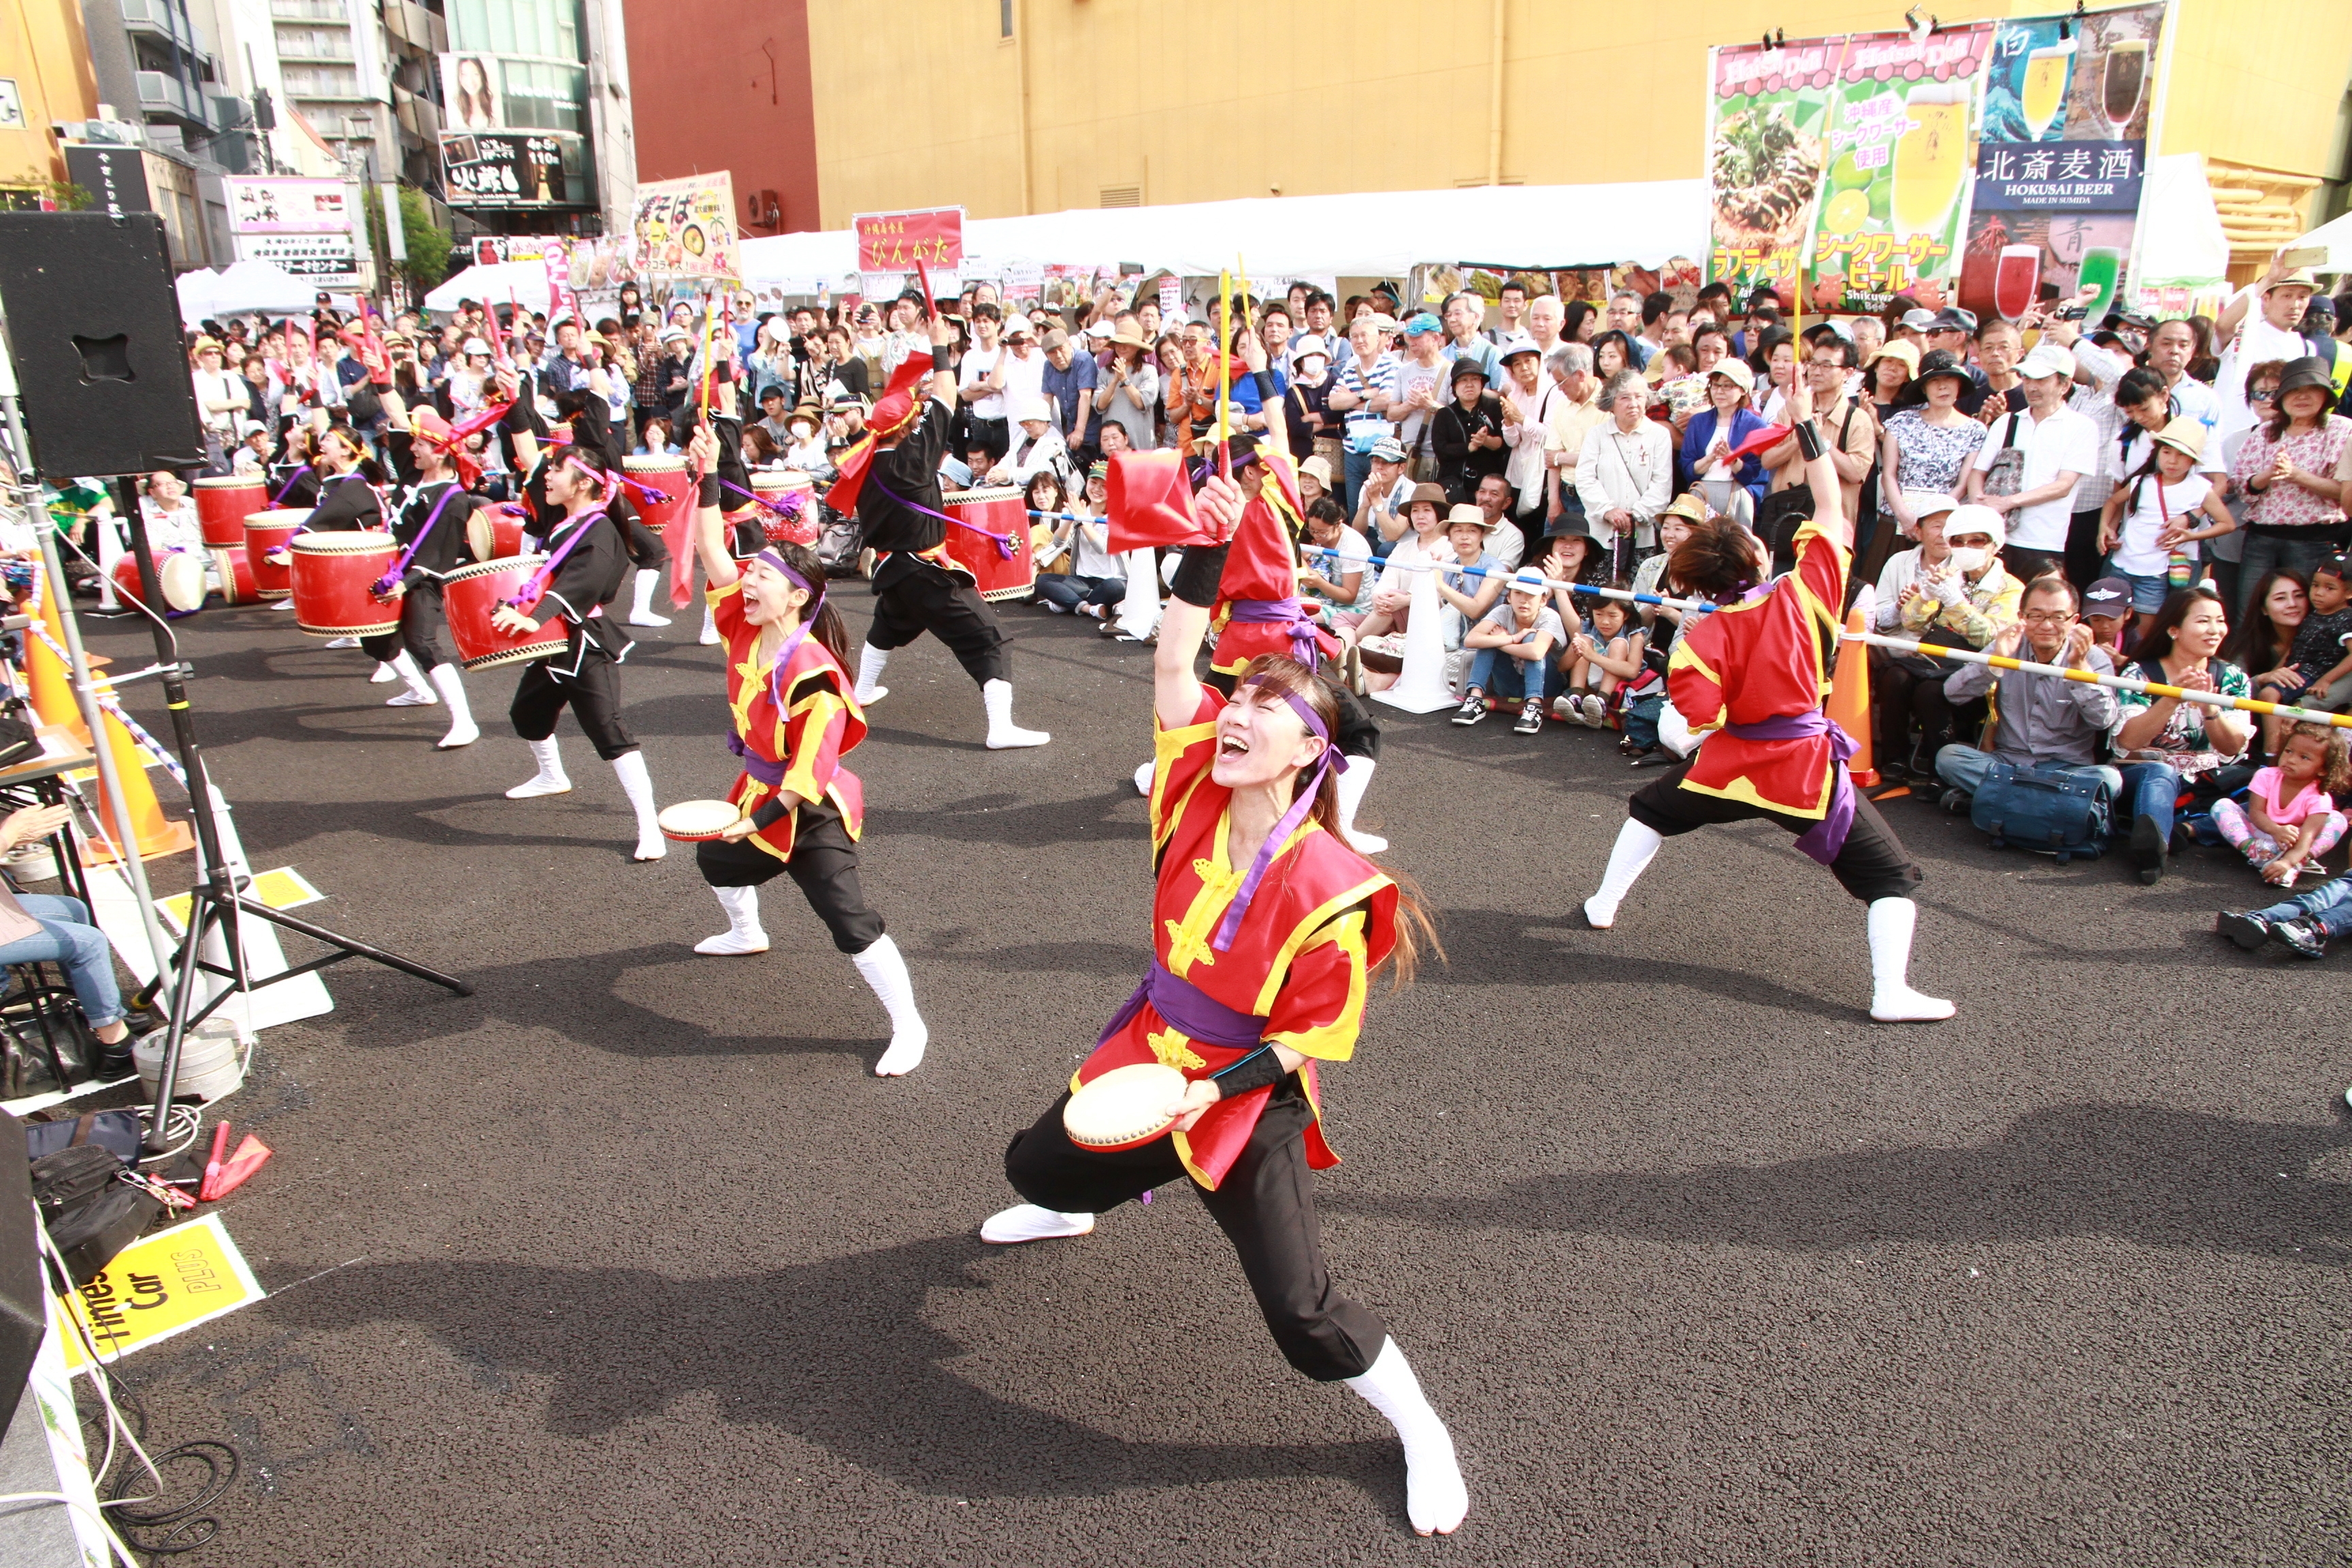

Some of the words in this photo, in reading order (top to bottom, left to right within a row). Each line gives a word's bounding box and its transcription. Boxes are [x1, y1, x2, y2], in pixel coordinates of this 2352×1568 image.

[1783, 48, 1823, 79] Deli
[1855, 39, 1925, 70] Haisai
[1925, 37, 1969, 67] Deli
[1844, 99, 1895, 122] 沖縄産
[1832, 118, 1921, 149] シークワーサー
[1853, 147, 1888, 170] 使用
[1984, 148, 2134, 182] 北斎麦酒
[2004, 184, 2072, 197] HOKUSAI
[2074, 183, 2114, 196] BEER
[872, 233, 949, 267] びんがた
[1815, 231, 1948, 267] シークワーサー
[1848, 262, 1910, 292] ビール
[1846, 289, 1895, 302] Shikuwa
[1865, 301, 1888, 312] Bee
[1407, 375, 1437, 385] ROCHESTE
[170, 1249, 222, 1294] PLUS
[125, 1273, 169, 1310] Car
